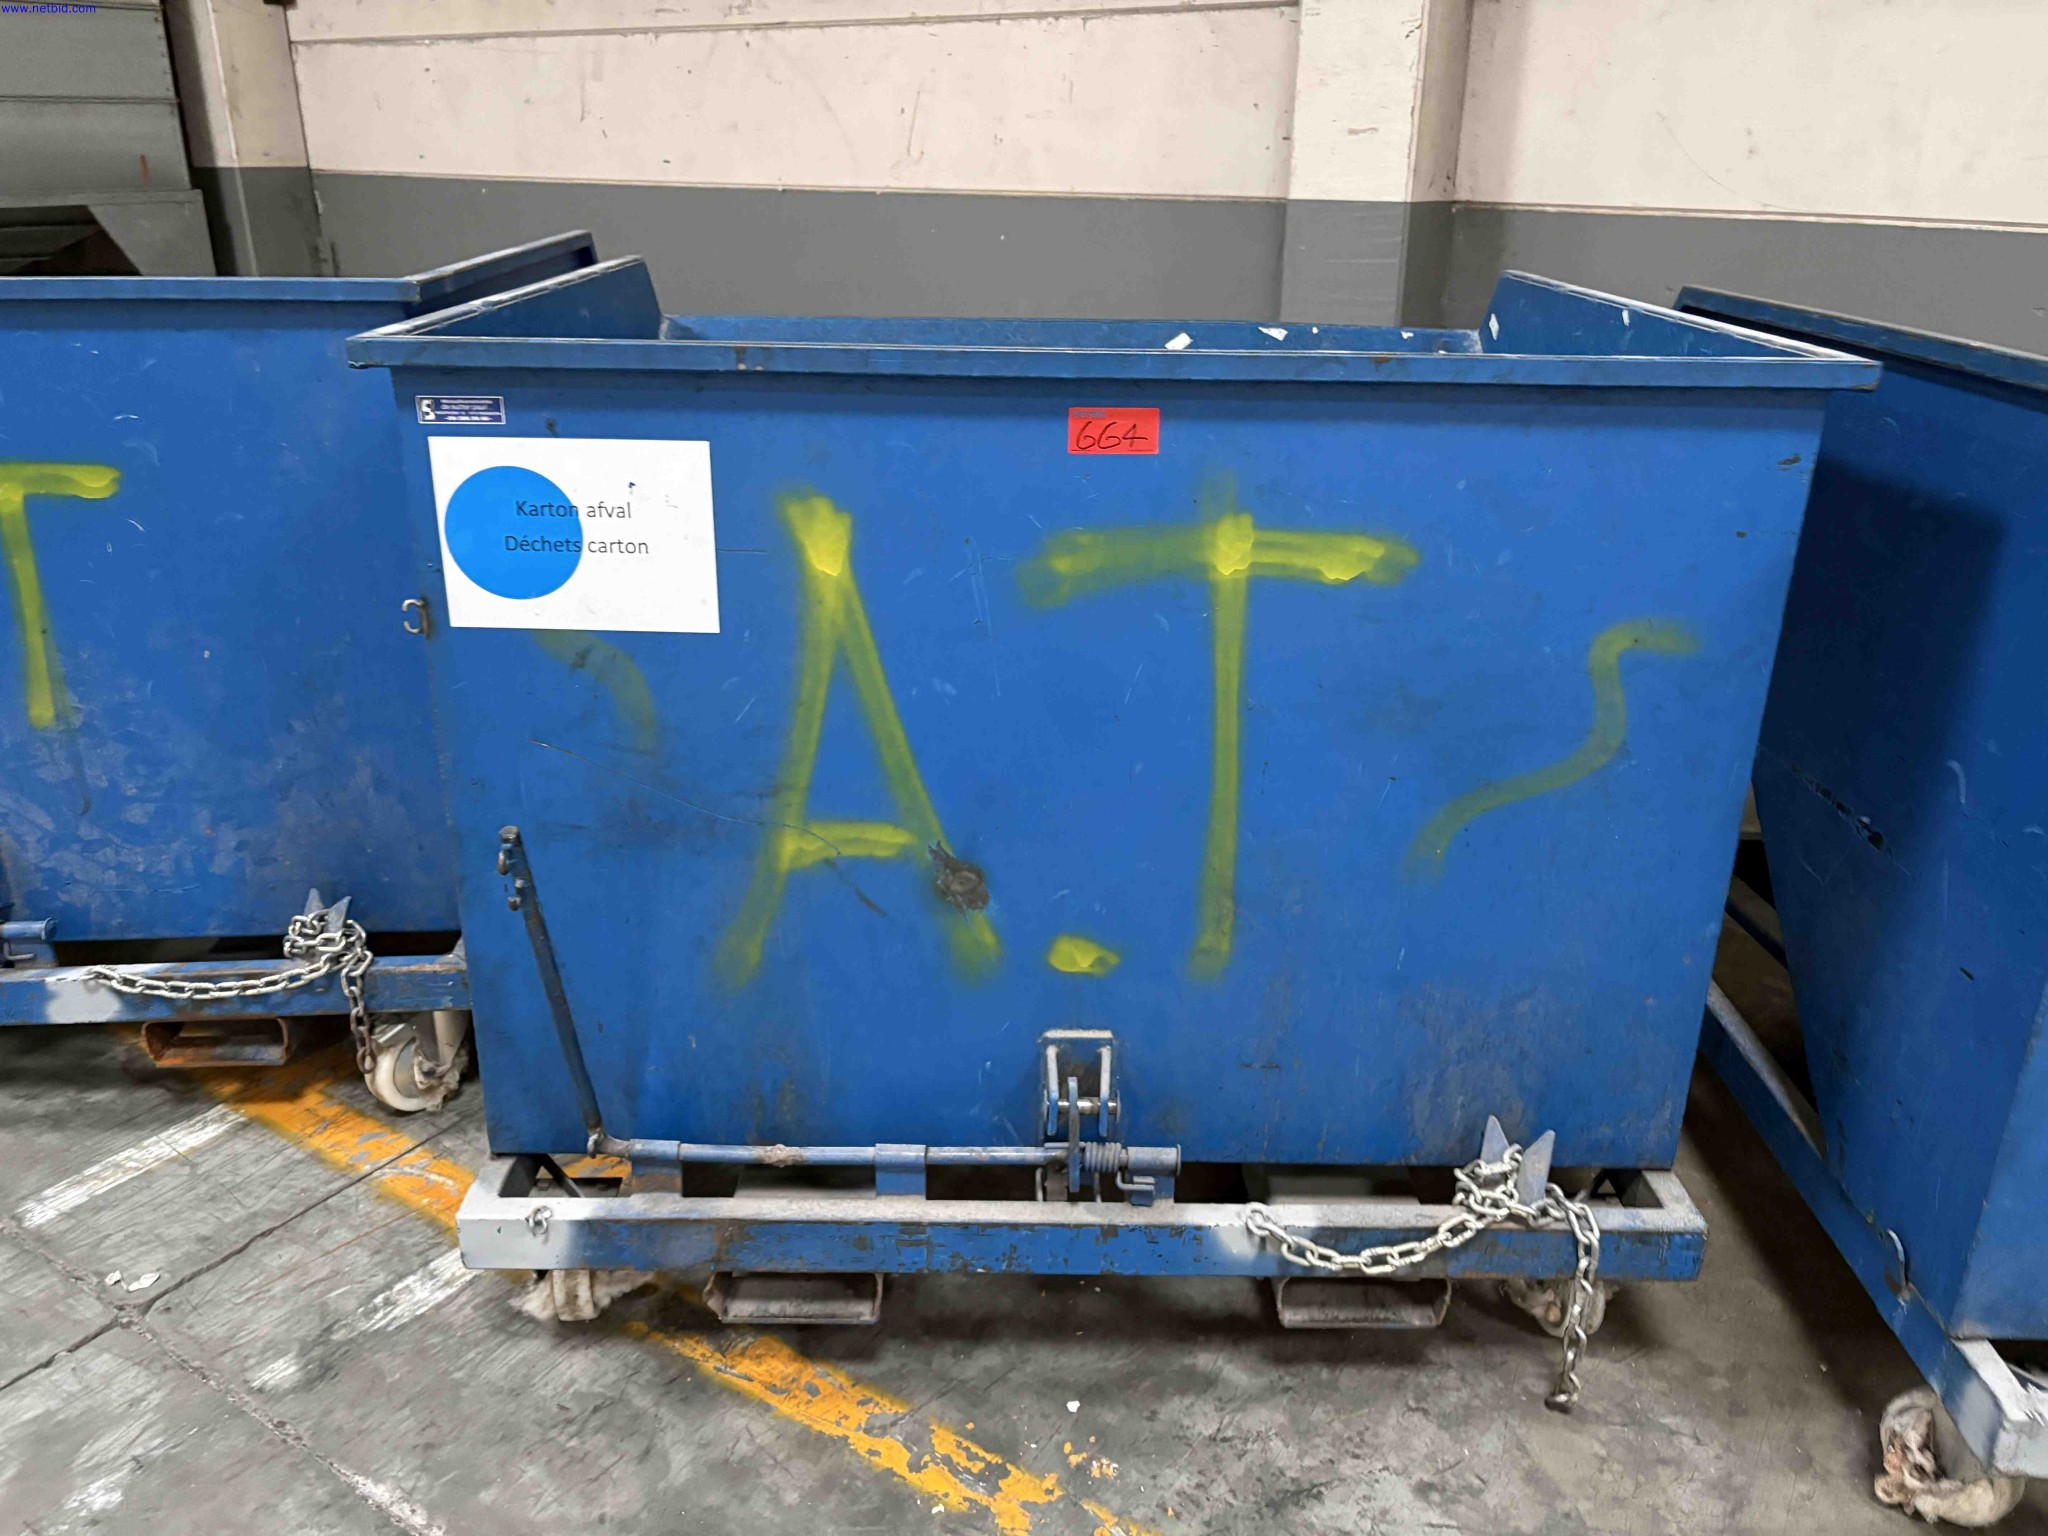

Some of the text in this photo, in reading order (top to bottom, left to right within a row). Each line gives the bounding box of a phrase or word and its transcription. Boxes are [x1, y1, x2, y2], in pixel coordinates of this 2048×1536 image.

[1076, 420, 1148, 450] 664
[516, 500, 632, 519] Karton afval
[505, 535, 649, 554] Déchets carton
